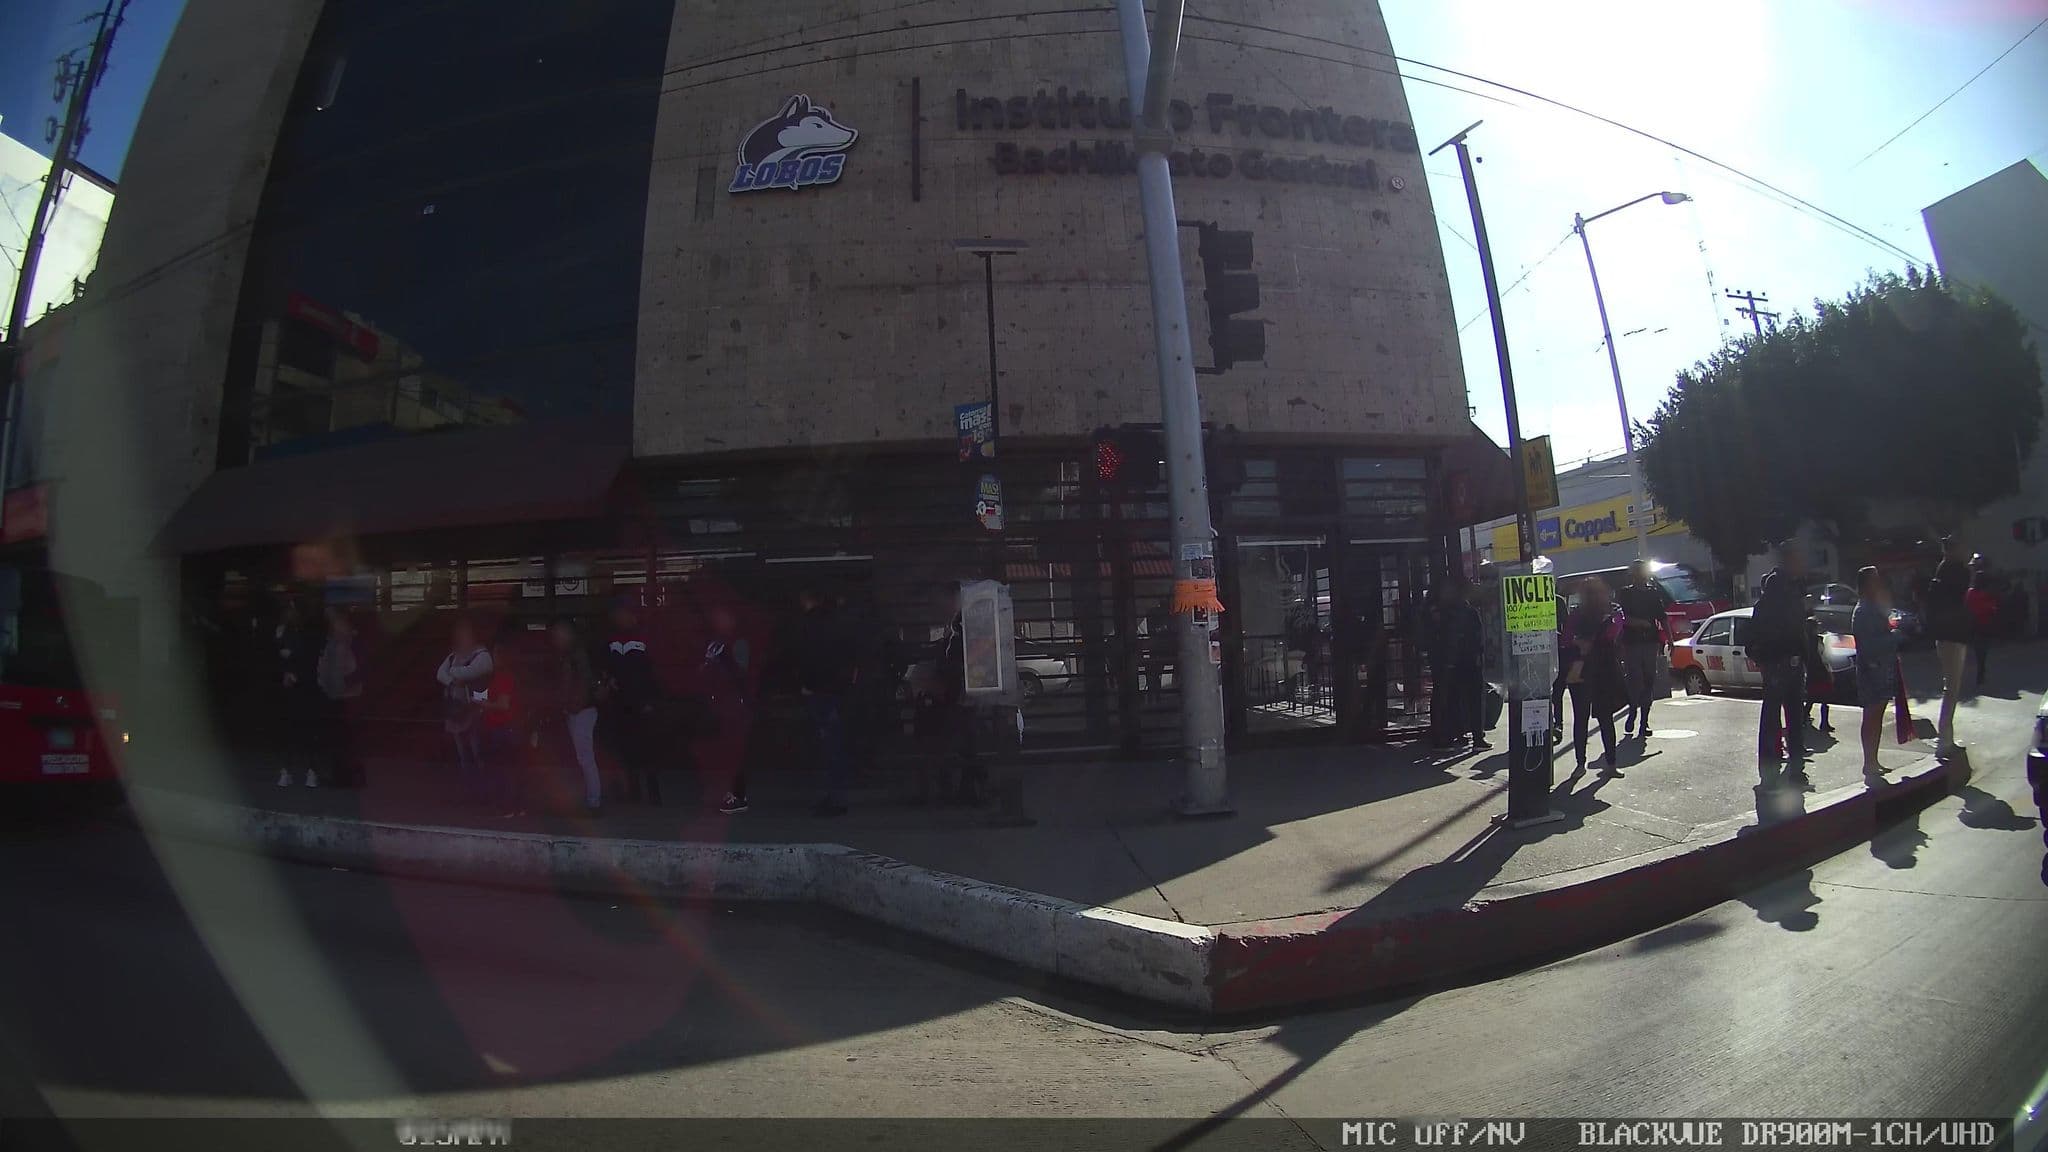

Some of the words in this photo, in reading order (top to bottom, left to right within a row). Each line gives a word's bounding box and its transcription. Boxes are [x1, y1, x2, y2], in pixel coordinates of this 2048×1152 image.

[956, 86, 1194, 132] Instituo
[1206, 93, 1417, 153] Frontera
[729, 154, 846, 192] LOBOS
[995, 140, 1233, 178] Bachillato
